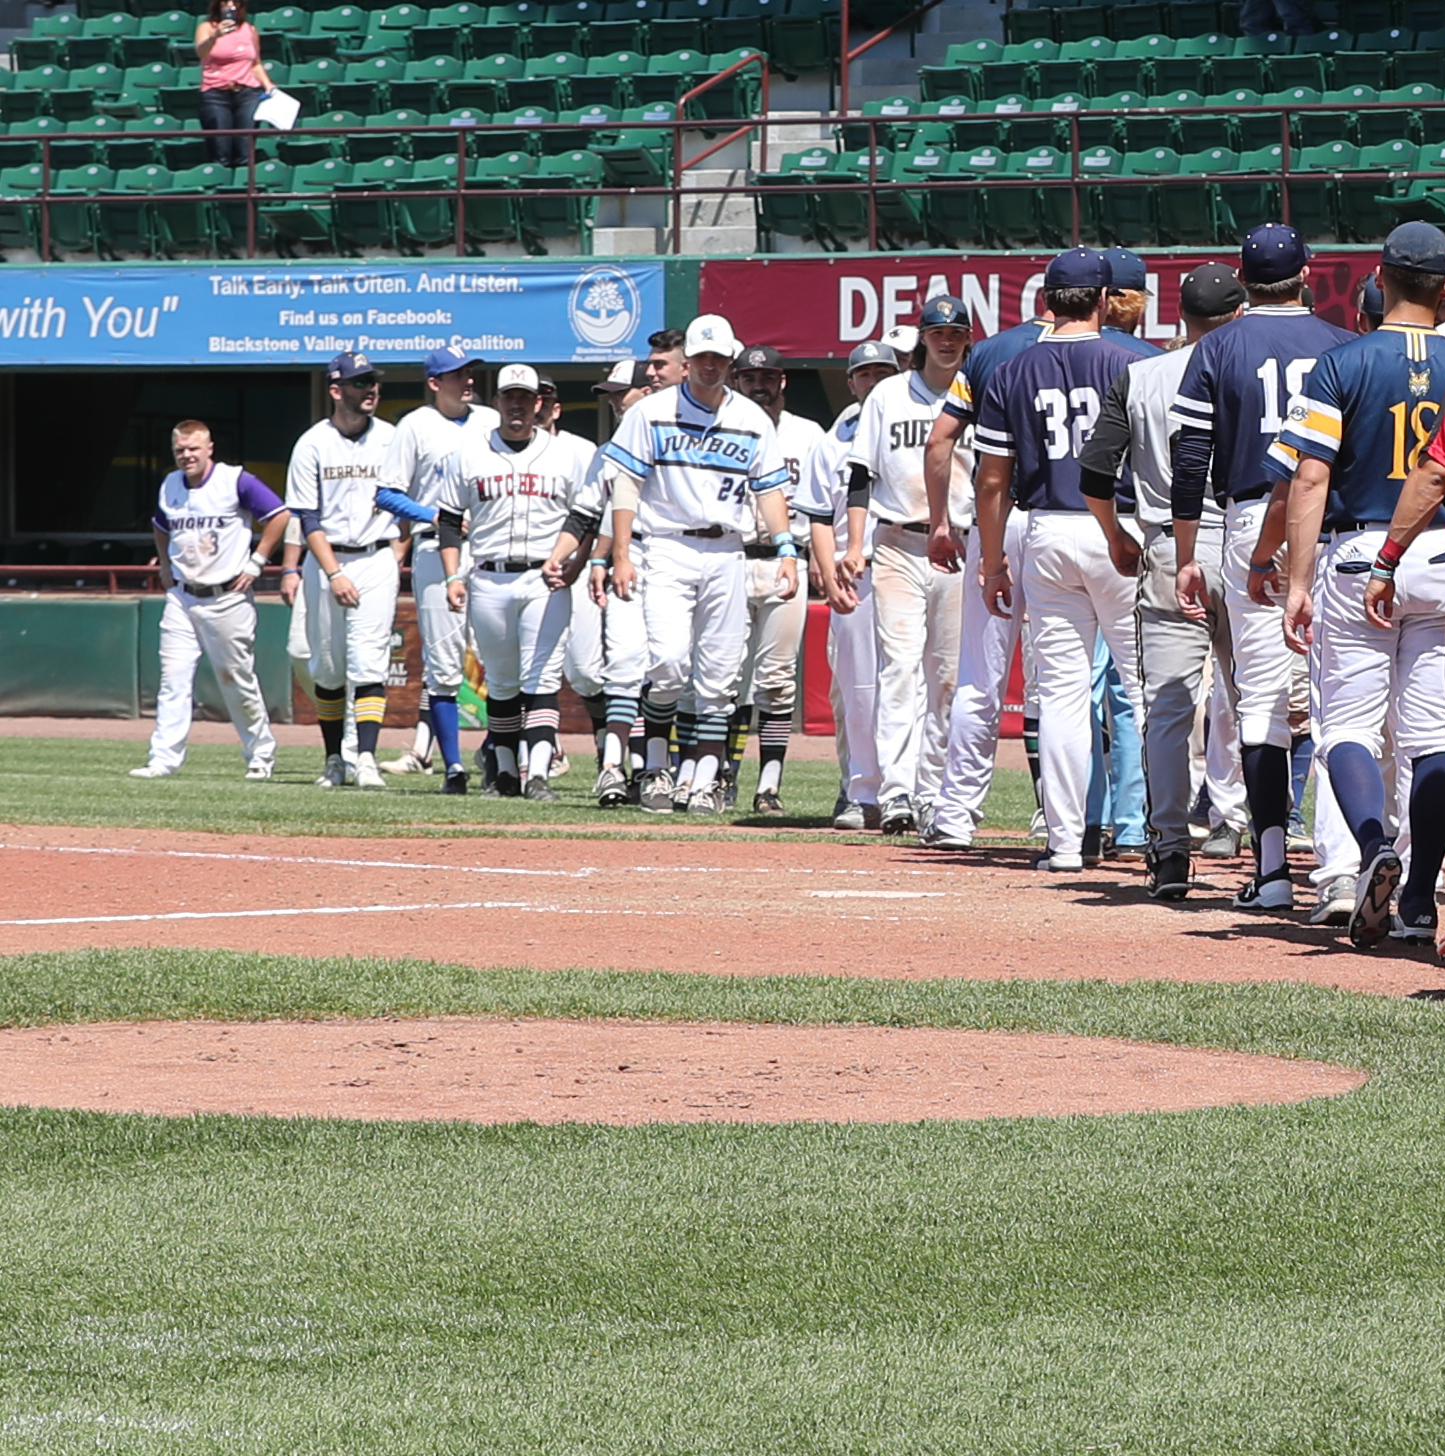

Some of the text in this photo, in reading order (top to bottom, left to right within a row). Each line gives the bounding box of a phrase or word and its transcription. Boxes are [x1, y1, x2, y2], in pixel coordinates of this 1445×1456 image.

[209, 273, 524, 299] Talk Early. Talk Often. And Listen.
[82, 296, 179, 338] You"
[279, 309, 452, 326] Find us on Facebook:
[209, 335, 525, 354] Blackstone Valley Prevention Coalition
[510, 368, 526, 381] M
[1034, 387, 1101, 460] 32
[1387, 401, 1440, 480] 18
[717, 477, 747, 505] 24
